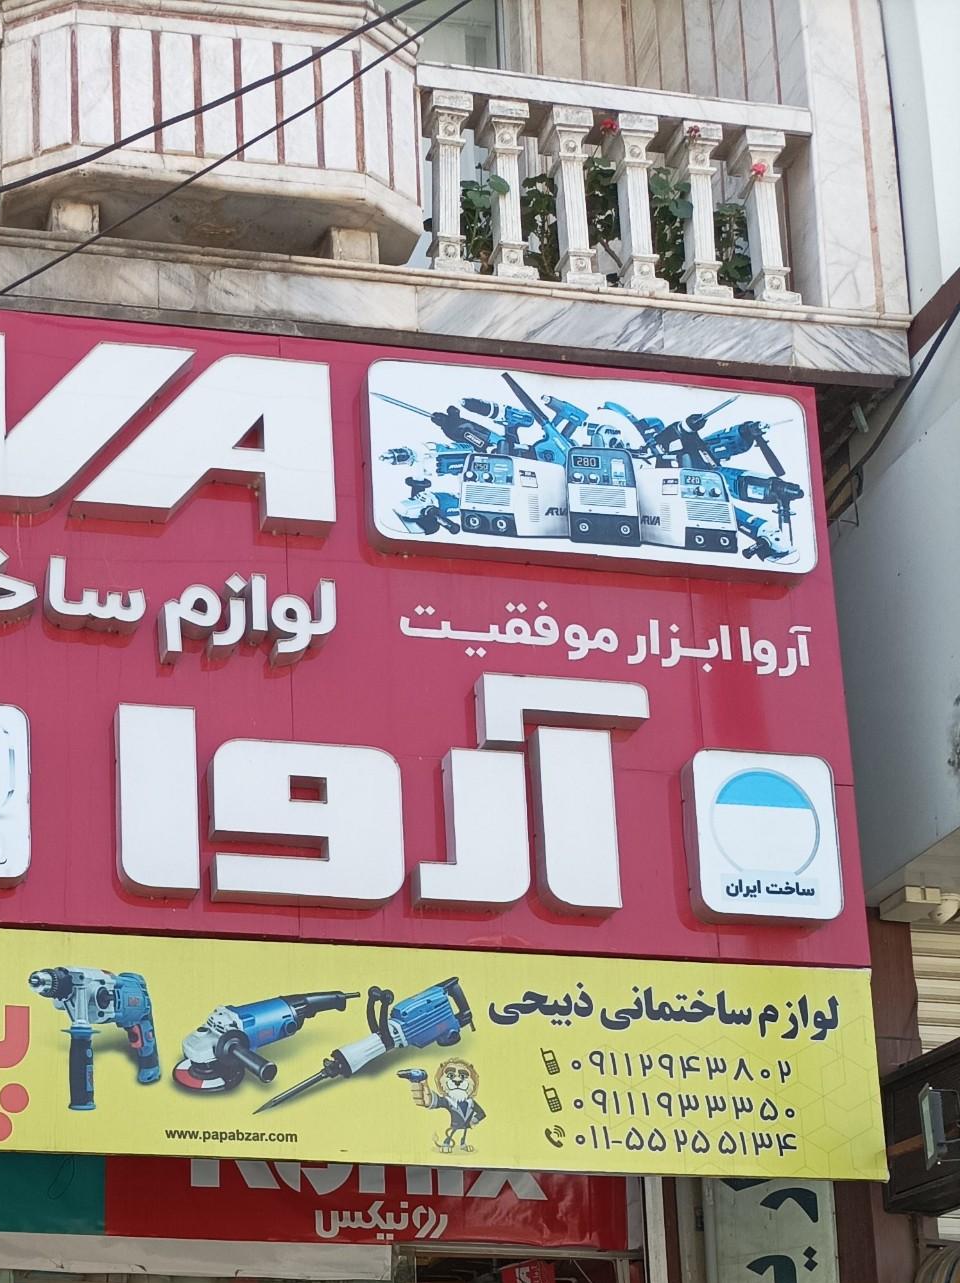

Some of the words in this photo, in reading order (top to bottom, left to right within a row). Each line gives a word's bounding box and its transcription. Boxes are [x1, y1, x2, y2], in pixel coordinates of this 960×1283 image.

[160, 573, 337, 664] لوازم
[398, 601, 619, 660] موفقیت
[629, 620, 733, 672] ابزار
[739, 625, 812, 677] آروا
[118, 672, 650, 908] آروا
[725, 880, 762, 898] ایران
[766, 880, 816, 897] ساخت
[488, 982, 594, 1027] ذبیحی
[600, 985, 752, 1031] ساختمانی
[758, 995, 840, 1040] لوازم
[571, 1050, 792, 1085] ۰۹۱۱۲۹۴۳۸۰۲
[573, 1088, 796, 1121] ۰۹۱۱۱۹۳۳۳۵۰
[165, 1127, 298, 1144] www.papabzar.com
[315, 1200, 449, 1241] رونیکس
